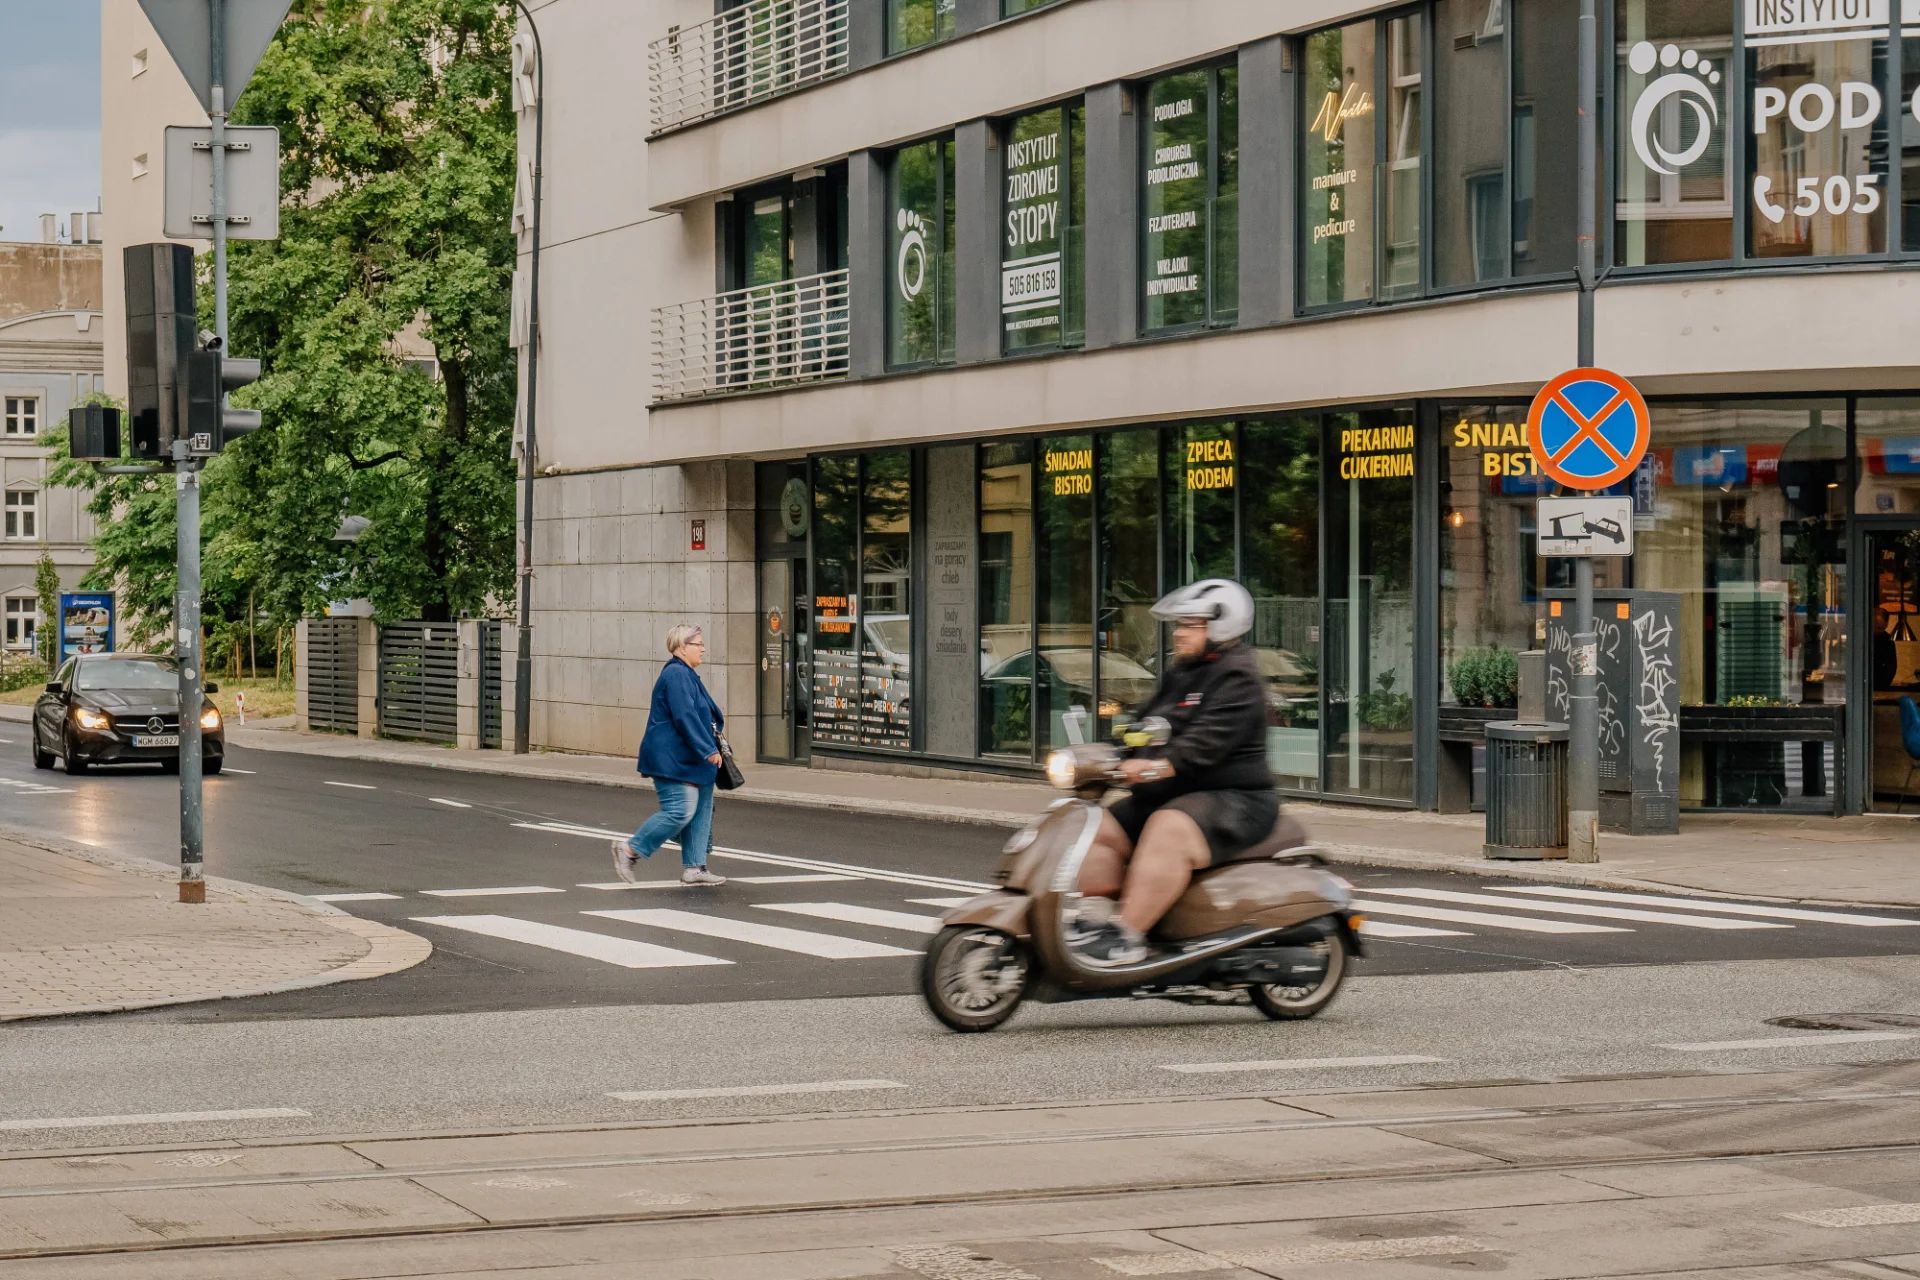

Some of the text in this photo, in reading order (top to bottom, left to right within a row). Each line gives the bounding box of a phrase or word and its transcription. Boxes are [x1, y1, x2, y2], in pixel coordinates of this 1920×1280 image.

[1154, 98, 1192, 122] PODOLOGIA
[1007, 132, 1058, 169] INSTYTUT
[1155, 143, 1191, 165] CHIRURGIA
[1007, 164, 1058, 203] ZDROWEJ
[1147, 161, 1199, 185] PODOLOGICZNA
[1312, 168, 1357, 190] manicure
[1329, 192, 1339, 211] &
[1793, 174, 1881, 216] 505
[1007, 200, 1058, 247] STOPY
[1148, 210, 1197, 233] FIZJOTERAPIA
[1313, 217, 1355, 245] pedicure
[1156, 255, 1188, 276] WKŁADKI
[1009, 269, 1056, 297] 505 816 158
[1146, 274, 1198, 297] INDYWIDUALNE
[1341, 425, 1414, 453] PIEKARNIA
[1340, 453, 1414, 480] CUKIERNIA
[1483, 452, 1545, 477] BIST
[1054, 474, 1092, 496] BISTRO
[1187, 466, 1233, 490] RODEM
[692, 526, 704, 542] 198
[829, 674, 844, 688] ZUPY
[878, 676, 894, 691] ZUPY
[824, 696, 848, 710] PIEROGI
[873, 699, 898, 714] PIEROGI
